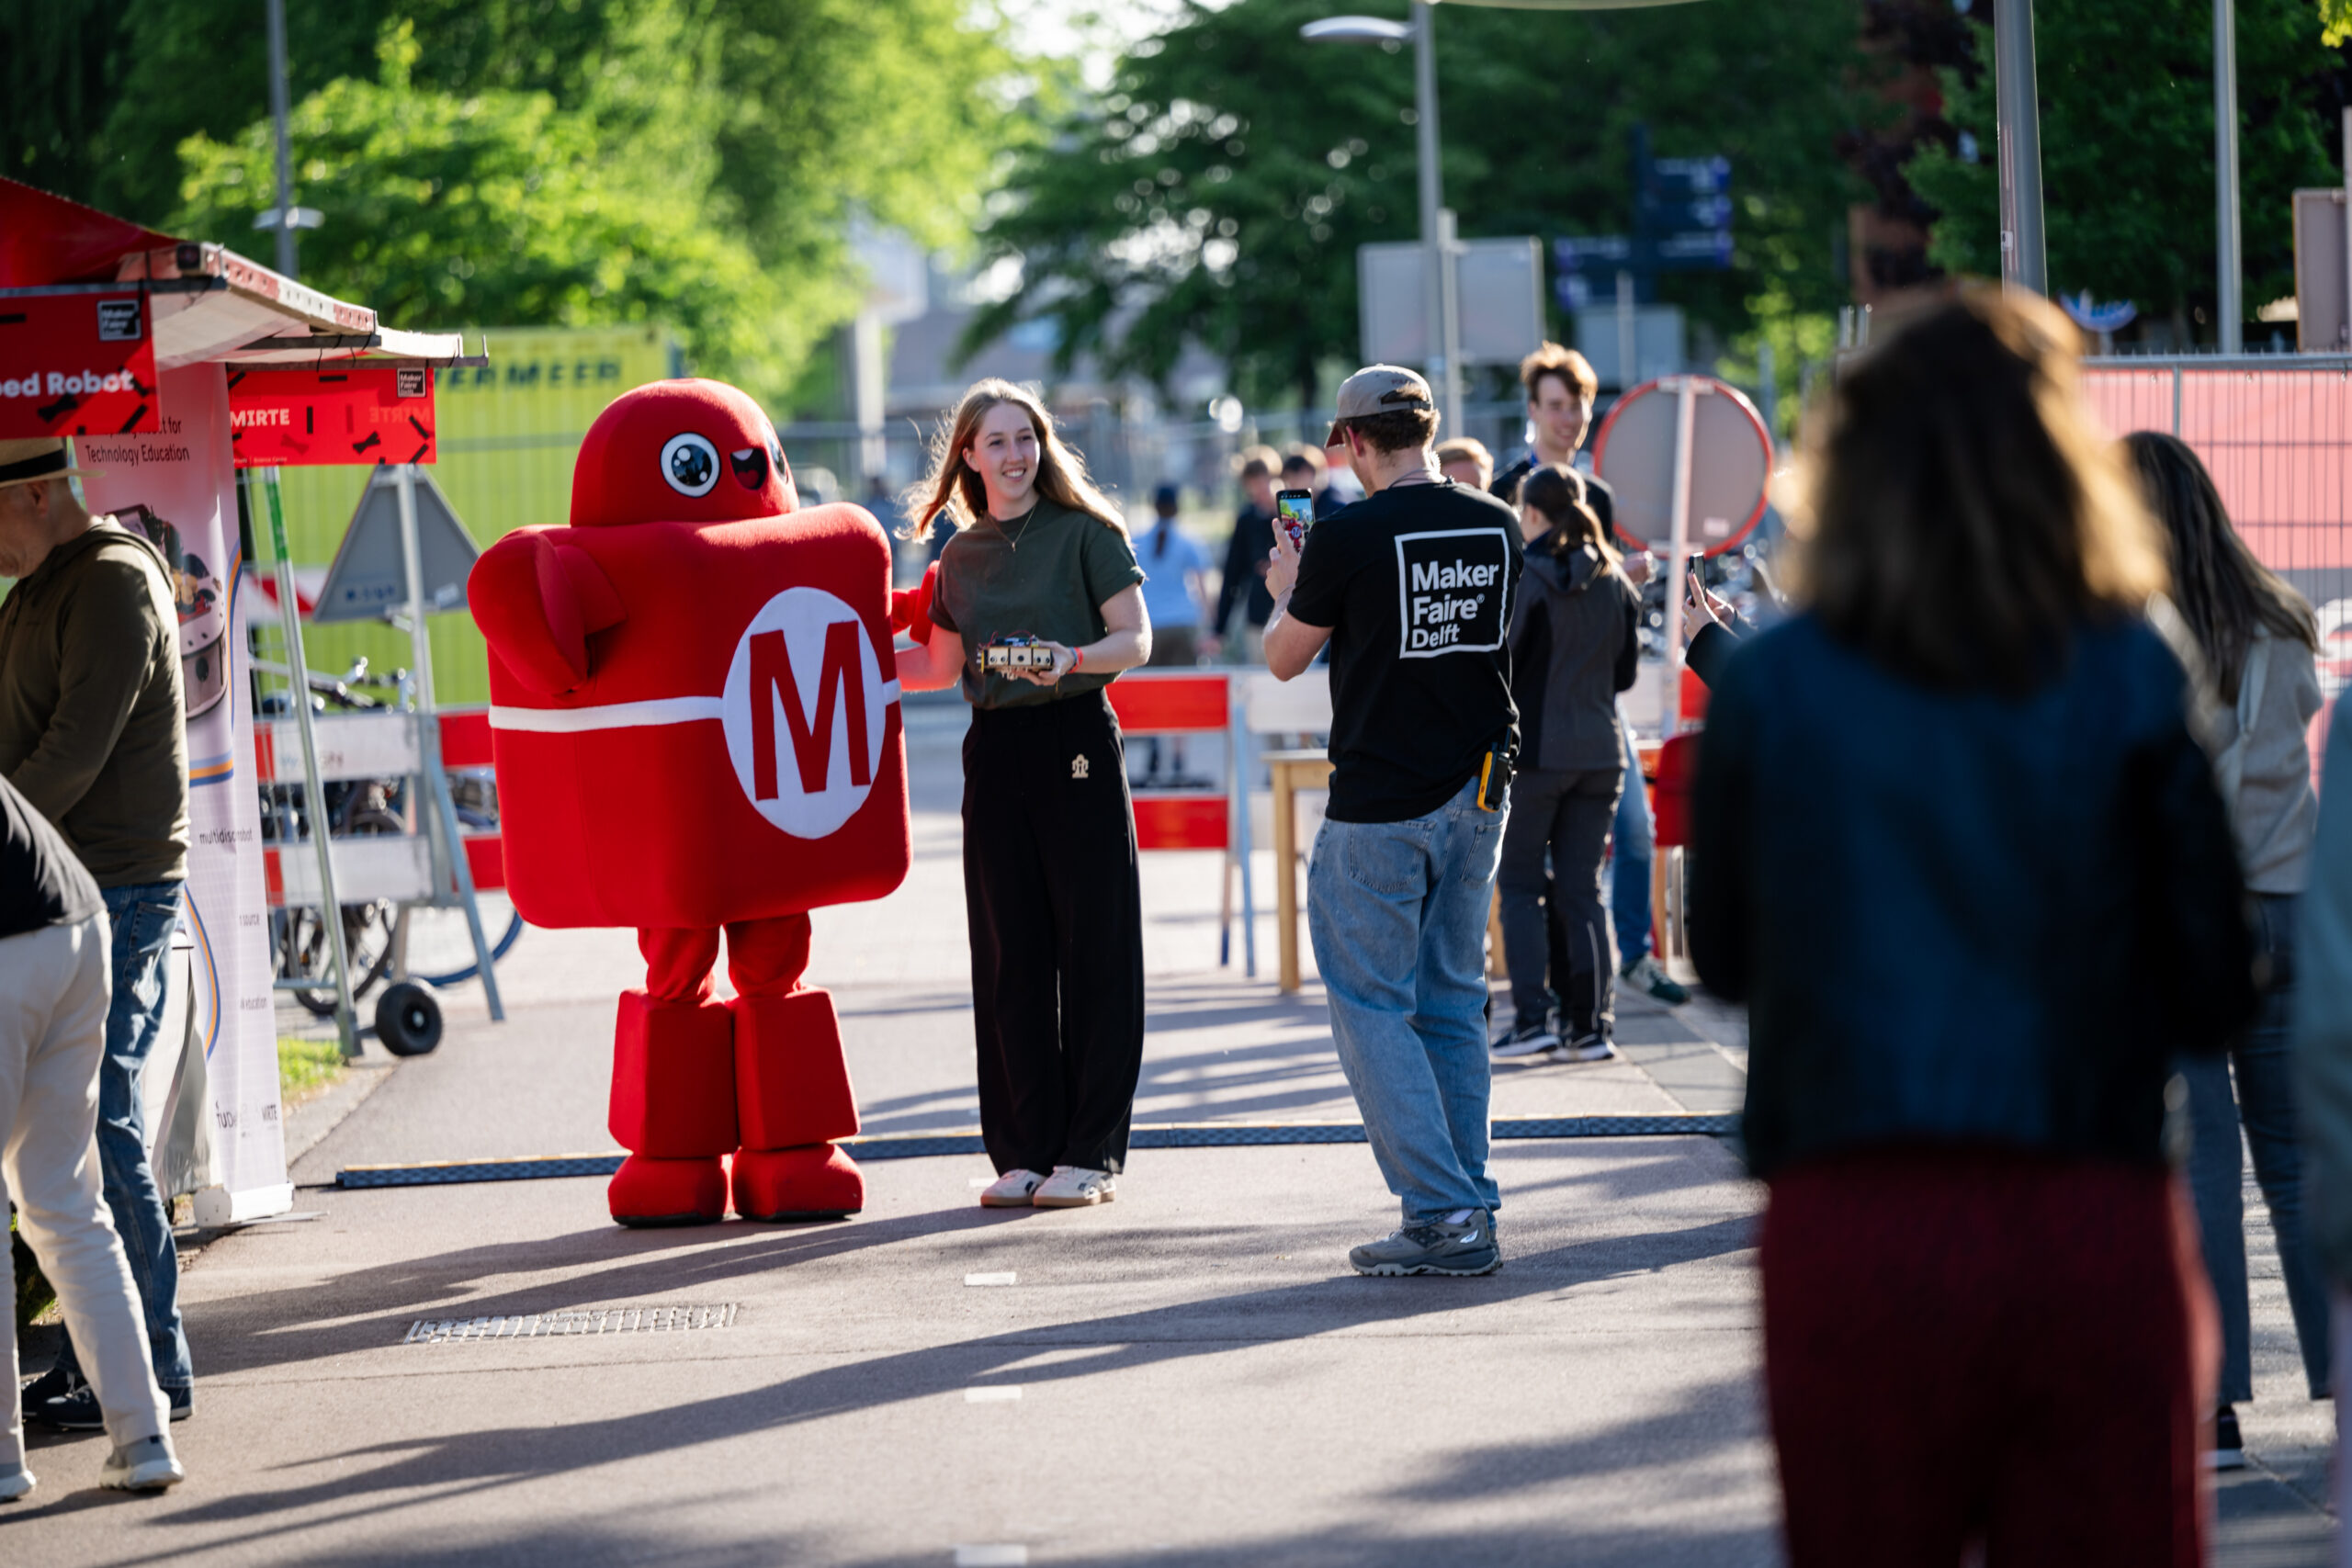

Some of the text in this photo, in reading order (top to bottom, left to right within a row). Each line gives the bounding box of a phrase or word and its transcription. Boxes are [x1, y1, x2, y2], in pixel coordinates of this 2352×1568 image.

[0, 368, 134, 399] ed Robot
[230, 408, 290, 427] MIRTE
[85, 444, 190, 467] Technology Education
[1411, 558, 1499, 592] Maker
[1411, 624, 1460, 649] Delft
[750, 619, 872, 802] M
